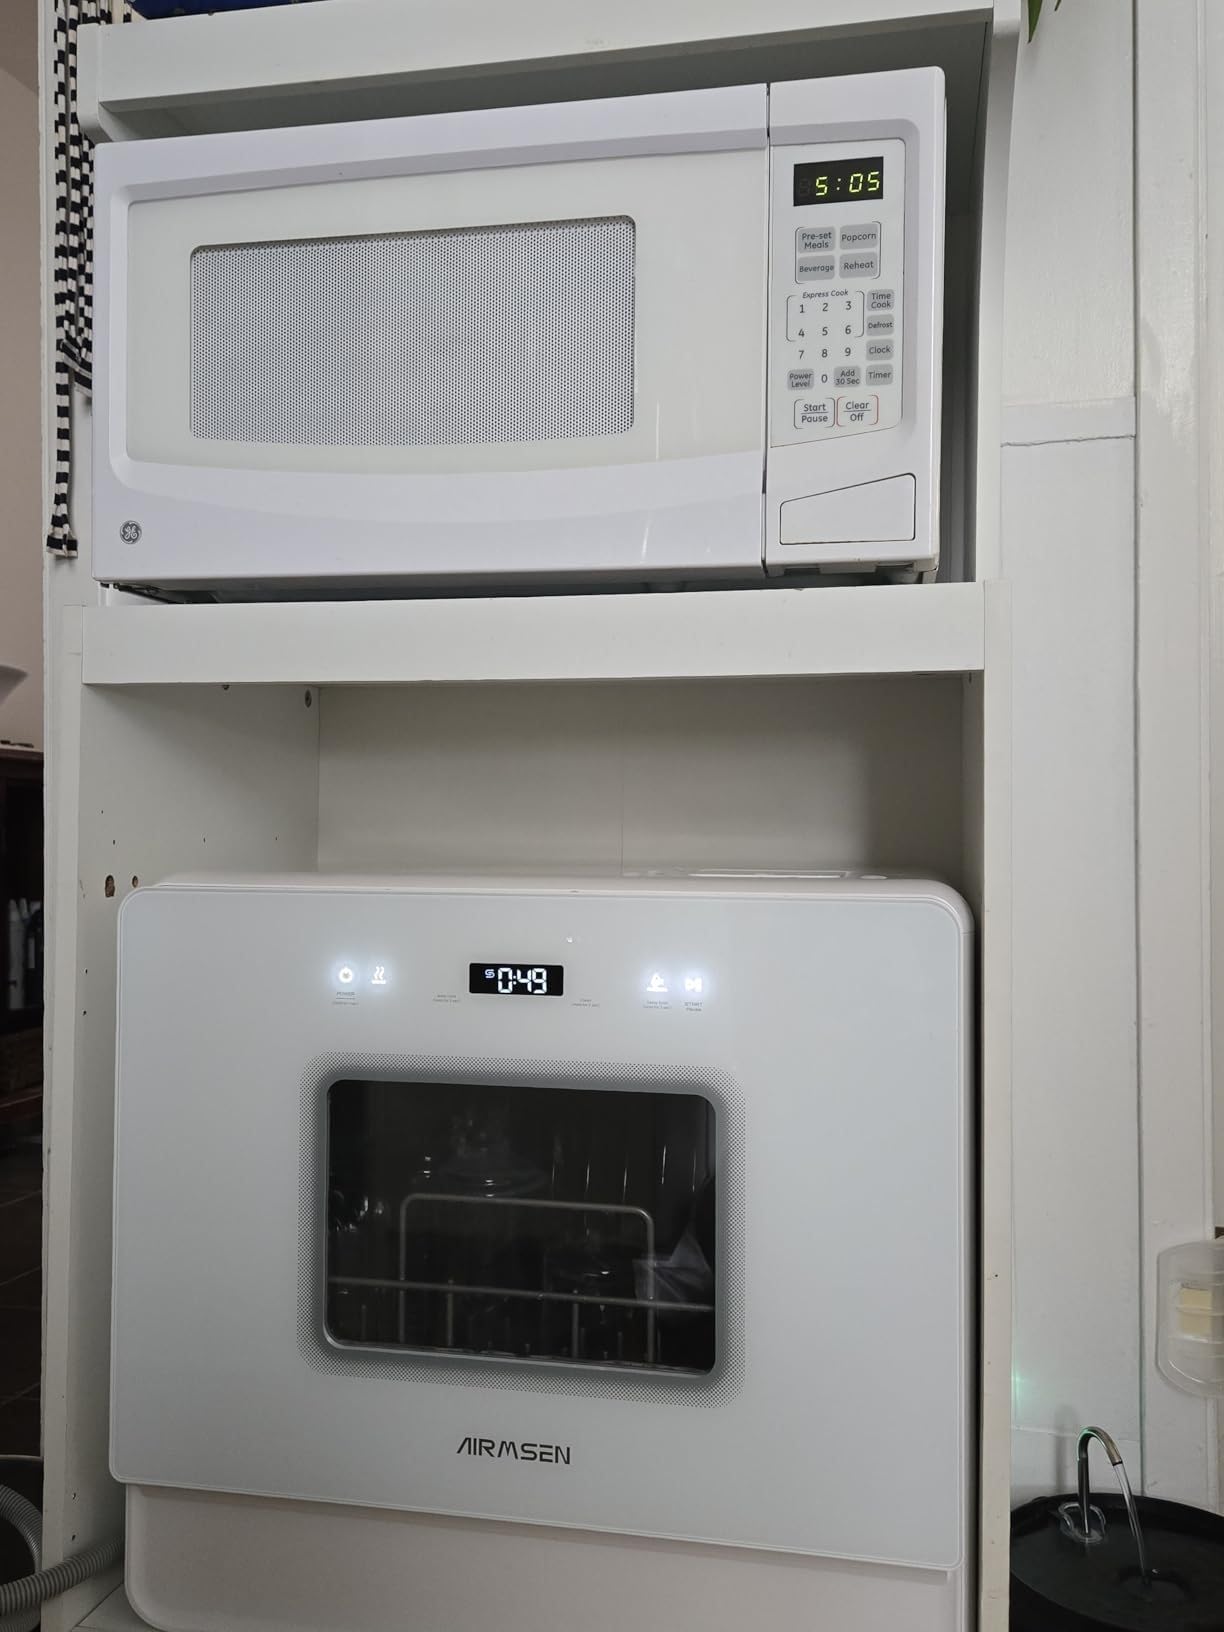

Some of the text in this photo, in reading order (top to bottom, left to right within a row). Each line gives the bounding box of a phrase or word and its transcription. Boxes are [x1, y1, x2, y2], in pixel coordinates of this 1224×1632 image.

[815, 171, 880, 196] 5:05
[801, 231, 833, 241] Pre-set
[841, 232, 877, 243] Popcorn
[804, 240, 829, 250] Meals
[799, 263, 835, 273] Beverage
[843, 260, 875, 271] Reheat
[802, 289, 849, 300] Express Cook
[871, 292, 892, 301] Time
[799, 300, 852, 314] 1 2 3
[870, 301, 892, 310] Cook
[867, 321, 894, 330] Defrost
[798, 324, 852, 338] 4 5 6
[798, 347, 851, 360] 7 8 9
[868, 345, 892, 355] Clock
[789, 372, 813, 381] Power
[821, 374, 828, 384] 0
[840, 370, 856, 378] Add
[867, 371, 892, 380] Timer
[791, 380, 811, 388] Level
[835, 377, 860, 386] 30 Sec
[803, 403, 827, 413] Start
[845, 400, 870, 411] Clear
[801, 416, 829, 424] Pause
[849, 412, 865, 423] Off
[497, 967, 548, 994] 0:49
[456, 1437, 571, 1465] AIRMSEN
